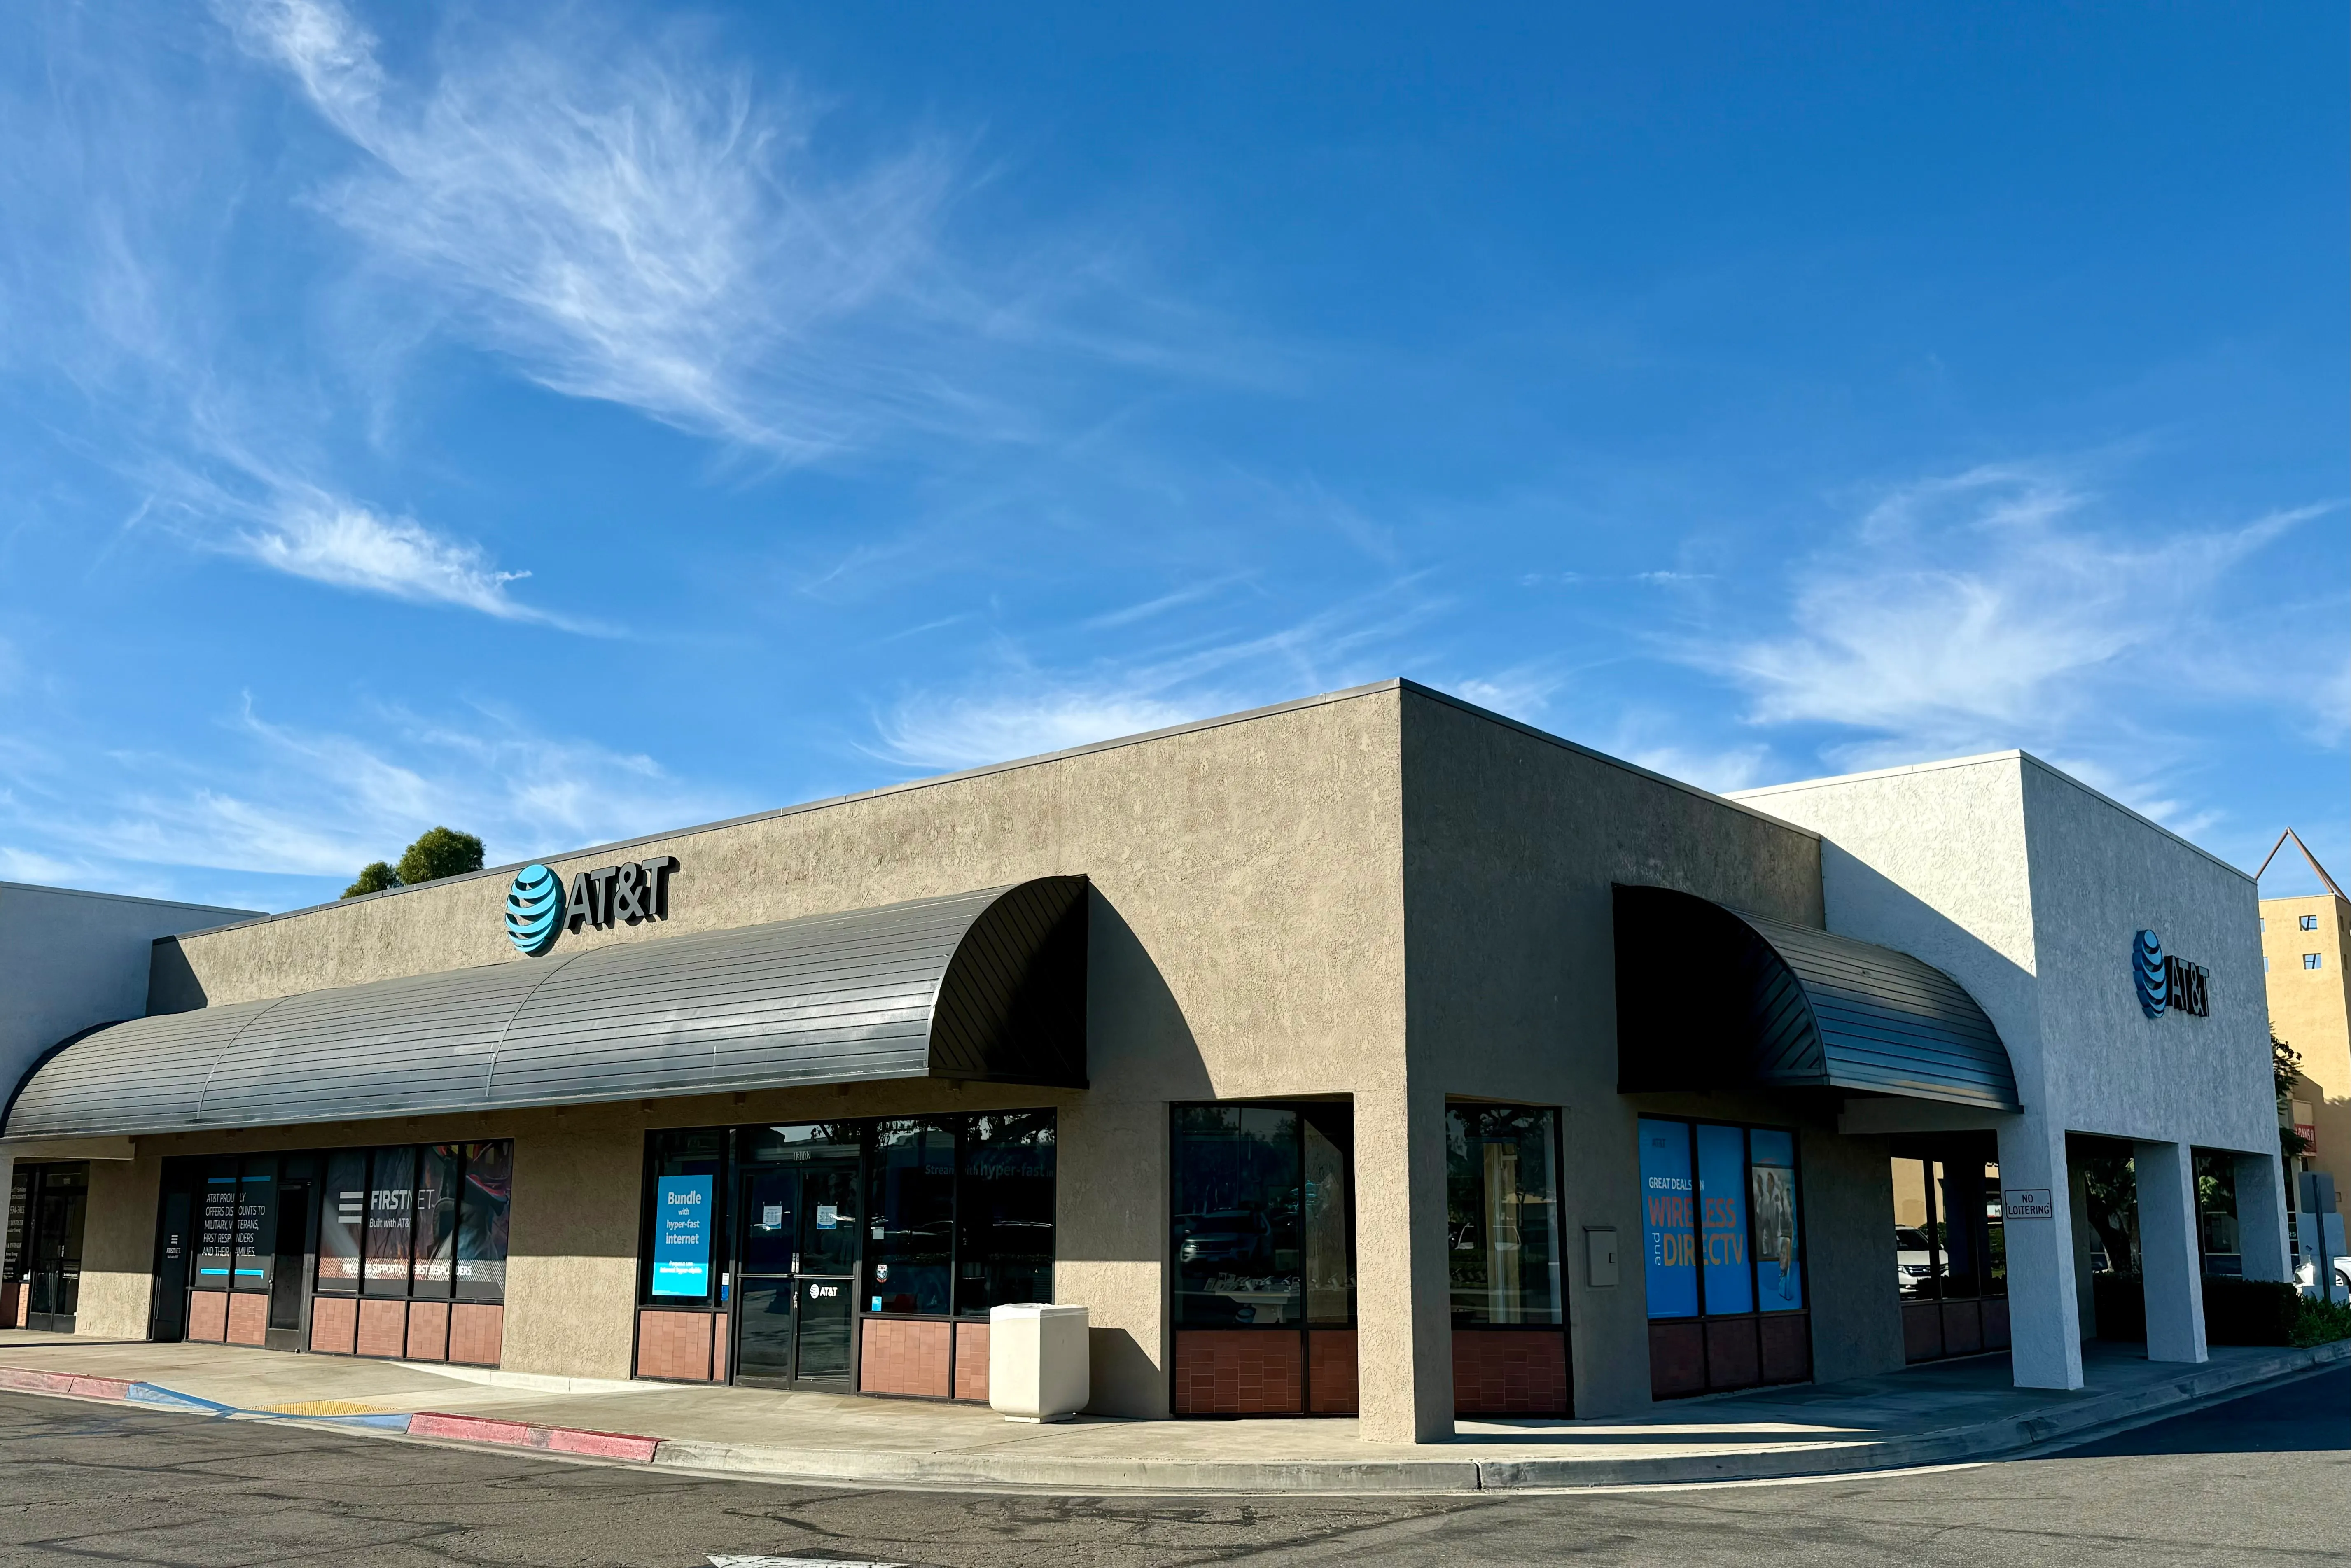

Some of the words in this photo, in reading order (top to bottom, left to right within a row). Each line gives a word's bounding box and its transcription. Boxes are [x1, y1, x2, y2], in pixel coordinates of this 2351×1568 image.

[564, 856, 677, 933] AT&T
[2165, 955, 2209, 1017] AT&T
[794, 1151, 810, 1160] 13102
[964, 1164, 978, 1175] ith
[981, 1161, 1044, 1180] hyper-fast
[1649, 1177, 1670, 1189] GREAT
[1672, 1178, 1692, 1190] DEALS
[206, 1194, 220, 1203] AT&T
[220, 1192, 246, 1203] PROULY
[668, 1190, 702, 1204] Bundle
[2022, 1194, 2033, 1203] NO
[206, 1206, 224, 1216] OFFERS
[225, 1206, 257, 1216] DISOUNTS
[258, 1205, 265, 1216] TO
[2008, 1205, 2050, 1215] LOITERING
[204, 1220, 228, 1231] MILITARY,
[229, 1219, 259, 1231] VTERANS,
[369, 1218, 382, 1228] Built
[383, 1218, 396, 1228] with
[397, 1218, 411, 1228] AT&
[667, 1219, 700, 1231] hyper-fast
[203, 1233, 217, 1243] FIRST
[218, 1233, 254, 1243] RESPNDERS
[666, 1232, 699, 1244] internet
[202, 1246, 214, 1256] AND
[215, 1246, 230, 1257] THEIR
[235, 1246, 256, 1257] AMILIES.
[1652, 1233, 1661, 1265] and
[342, 1263, 359, 1273] PROU
[372, 1263, 398, 1274] SUPPORT
[398, 1264, 409, 1274] OU
[429, 1265, 472, 1276] RESPODERS
[819, 1287, 838, 1297] AT&T
